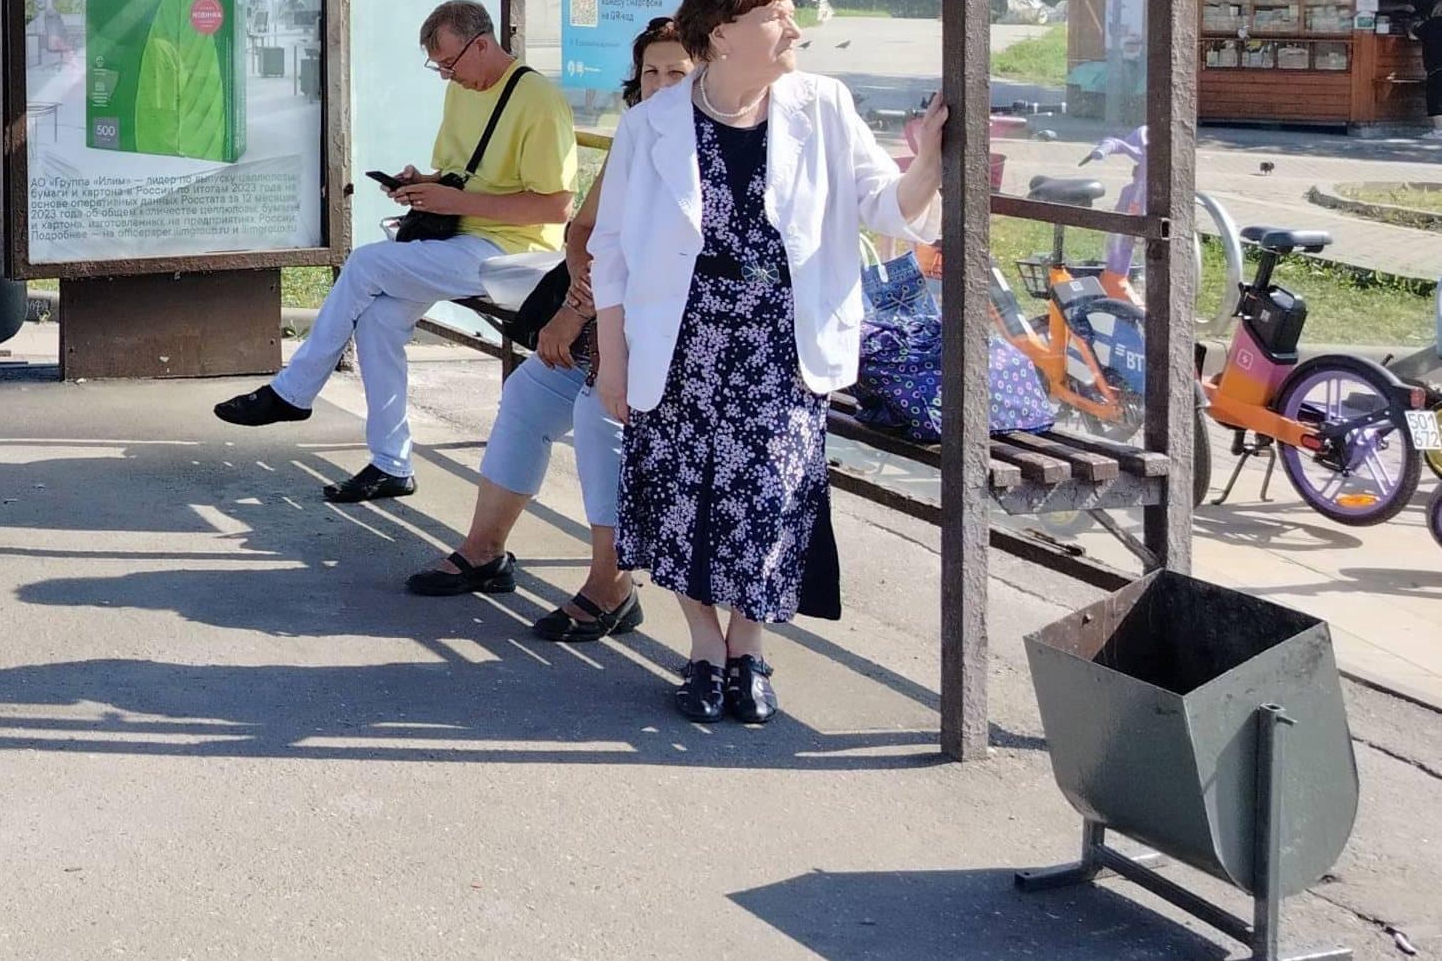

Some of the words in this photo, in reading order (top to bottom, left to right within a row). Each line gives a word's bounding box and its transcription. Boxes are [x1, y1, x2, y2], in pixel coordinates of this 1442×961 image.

[96, 125, 116, 137] 500
[1407, 412, 1438, 430] 501
[1414, 430, 1441, 448] 672
